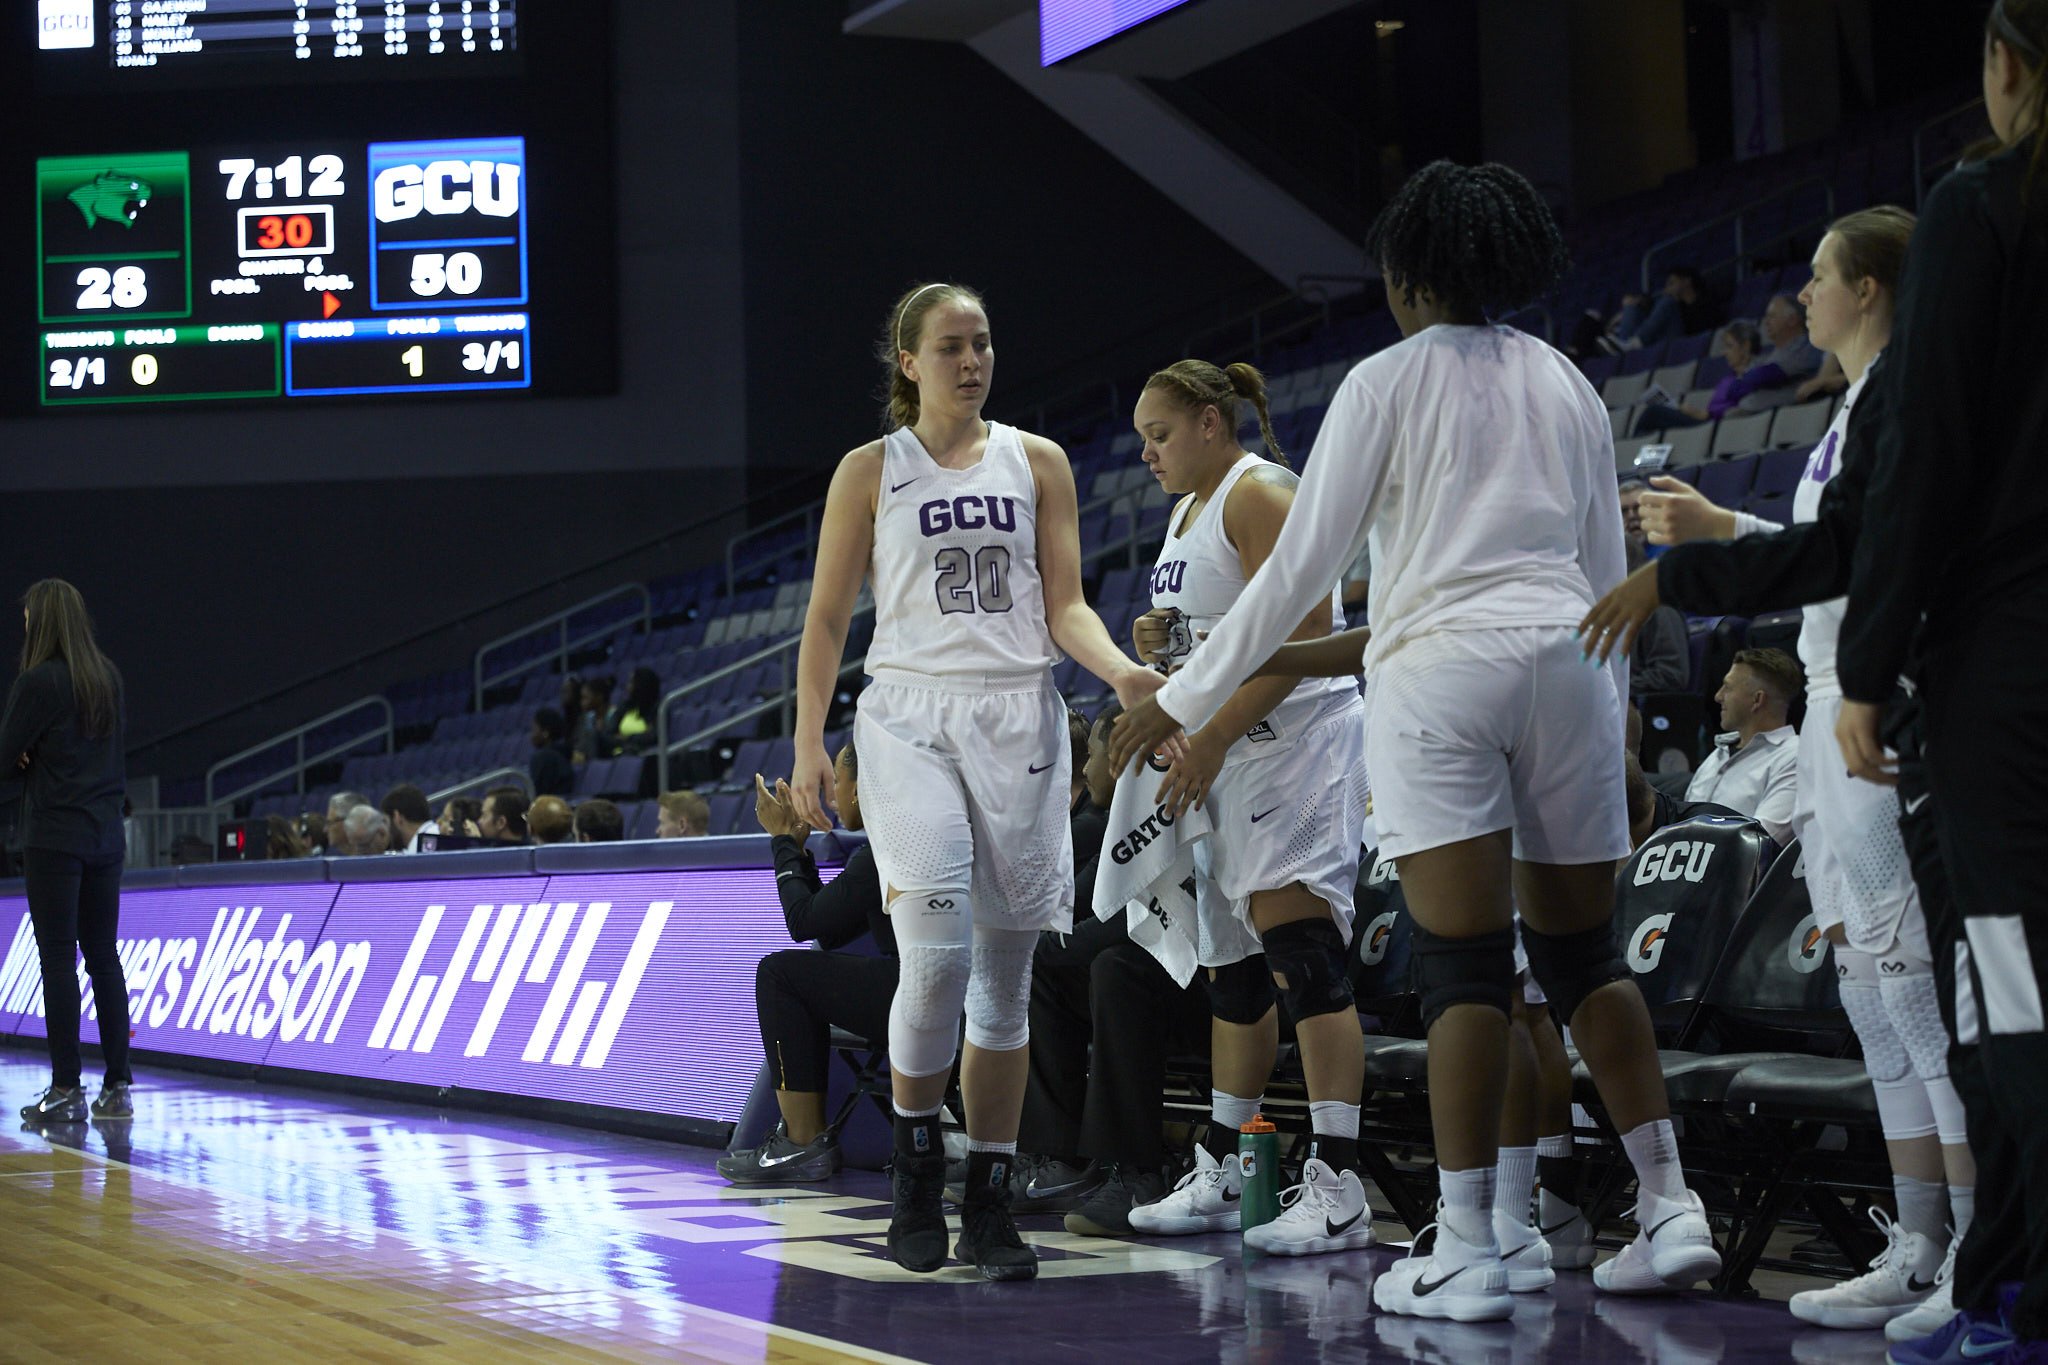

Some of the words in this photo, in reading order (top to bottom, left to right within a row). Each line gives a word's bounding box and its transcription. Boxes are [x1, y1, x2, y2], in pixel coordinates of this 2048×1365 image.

[43, 14, 89, 32] GCU
[218, 154, 345, 200] 7:12
[374, 160, 521, 223] GCU
[257, 214, 314, 250] 30
[76, 265, 148, 310] 28
[409, 251, 483, 297] 50
[49, 356, 106, 390] 2/1
[131, 353, 158, 386] 0
[401, 345, 423, 377] 1
[462, 340, 520, 374] 3/1
[919, 495, 1017, 538] GCU
[934, 545, 1014, 616] 20
[1632, 840, 1717, 887] GCU
[176, 906, 372, 1044] Watson
